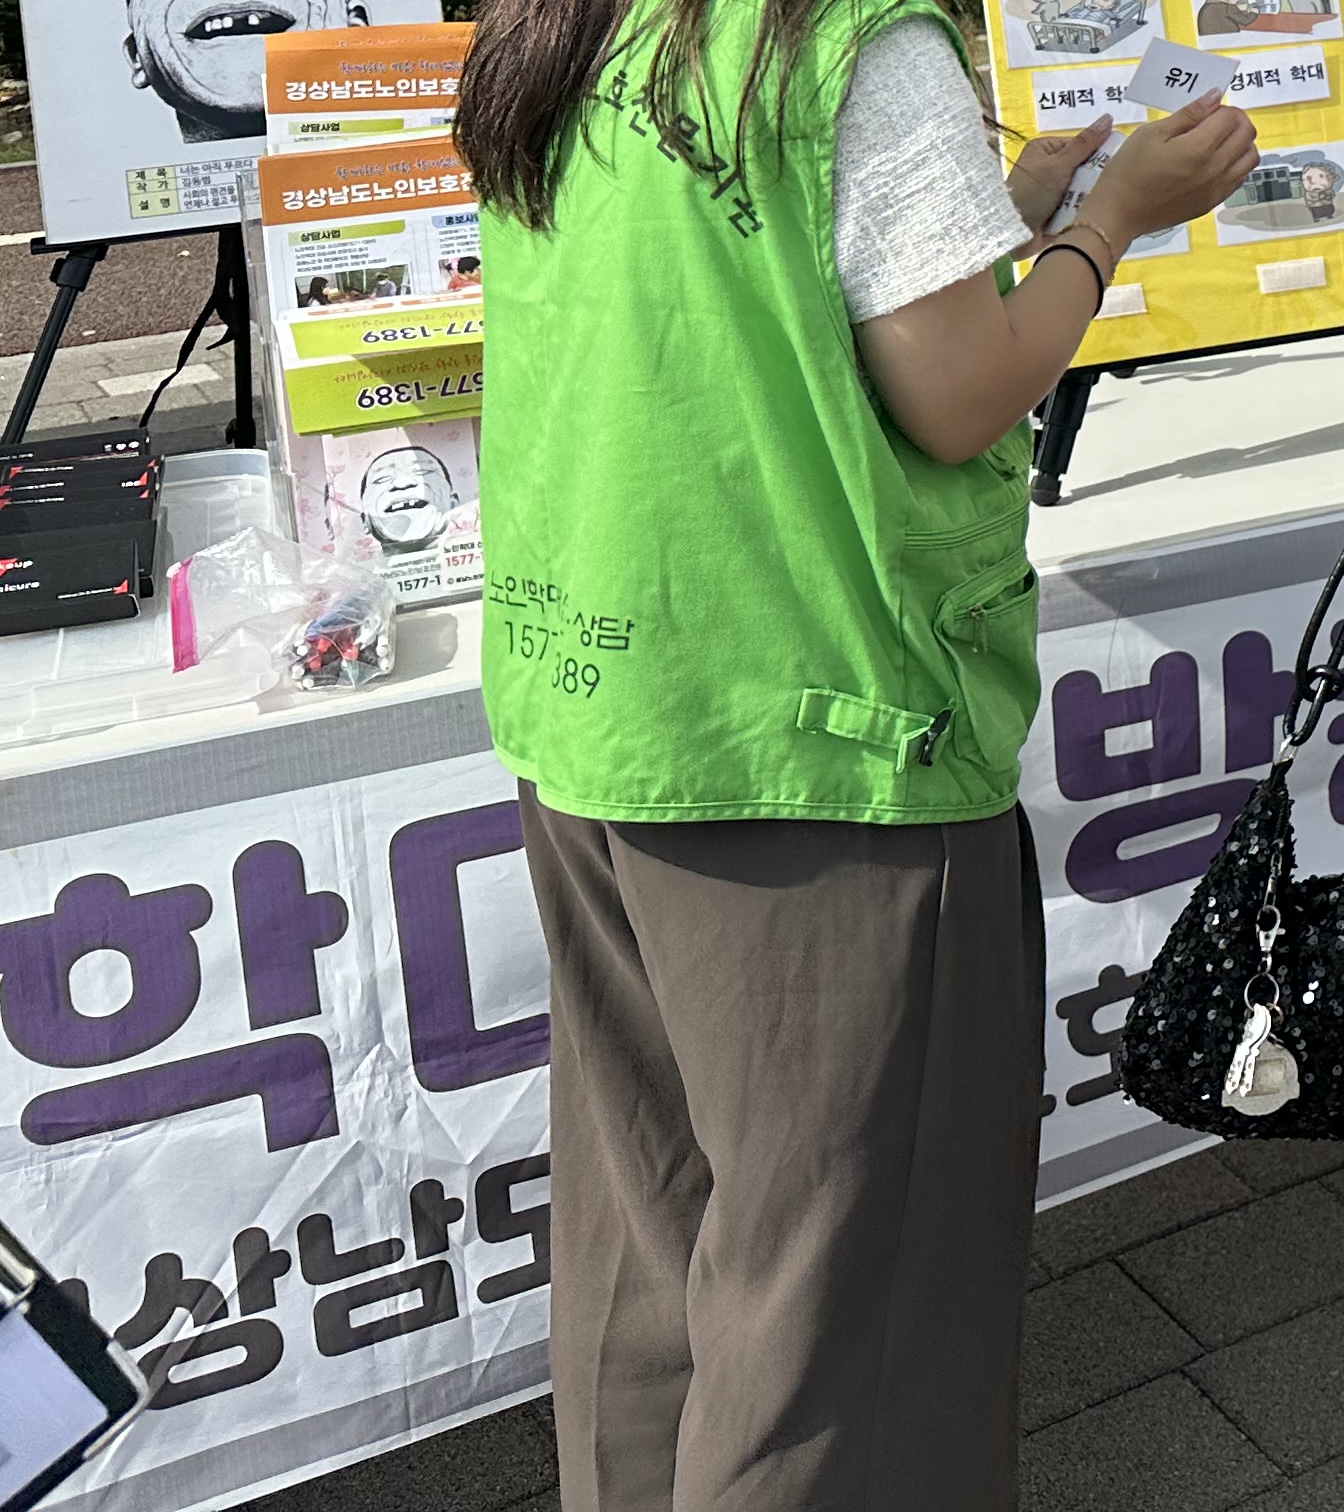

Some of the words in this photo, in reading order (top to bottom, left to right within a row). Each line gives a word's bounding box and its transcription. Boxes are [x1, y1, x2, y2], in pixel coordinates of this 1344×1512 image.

[285, 77, 461, 101] 경상남도노인보호
[1164, 67, 1200, 94] 유기
[1229, 68, 1281, 92] 경제적
[1290, 63, 1324, 83] 학대
[1038, 88, 1095, 111] 신체적
[1104, 85, 1127, 103] 학
[301, 229, 341, 242] 상담사업
